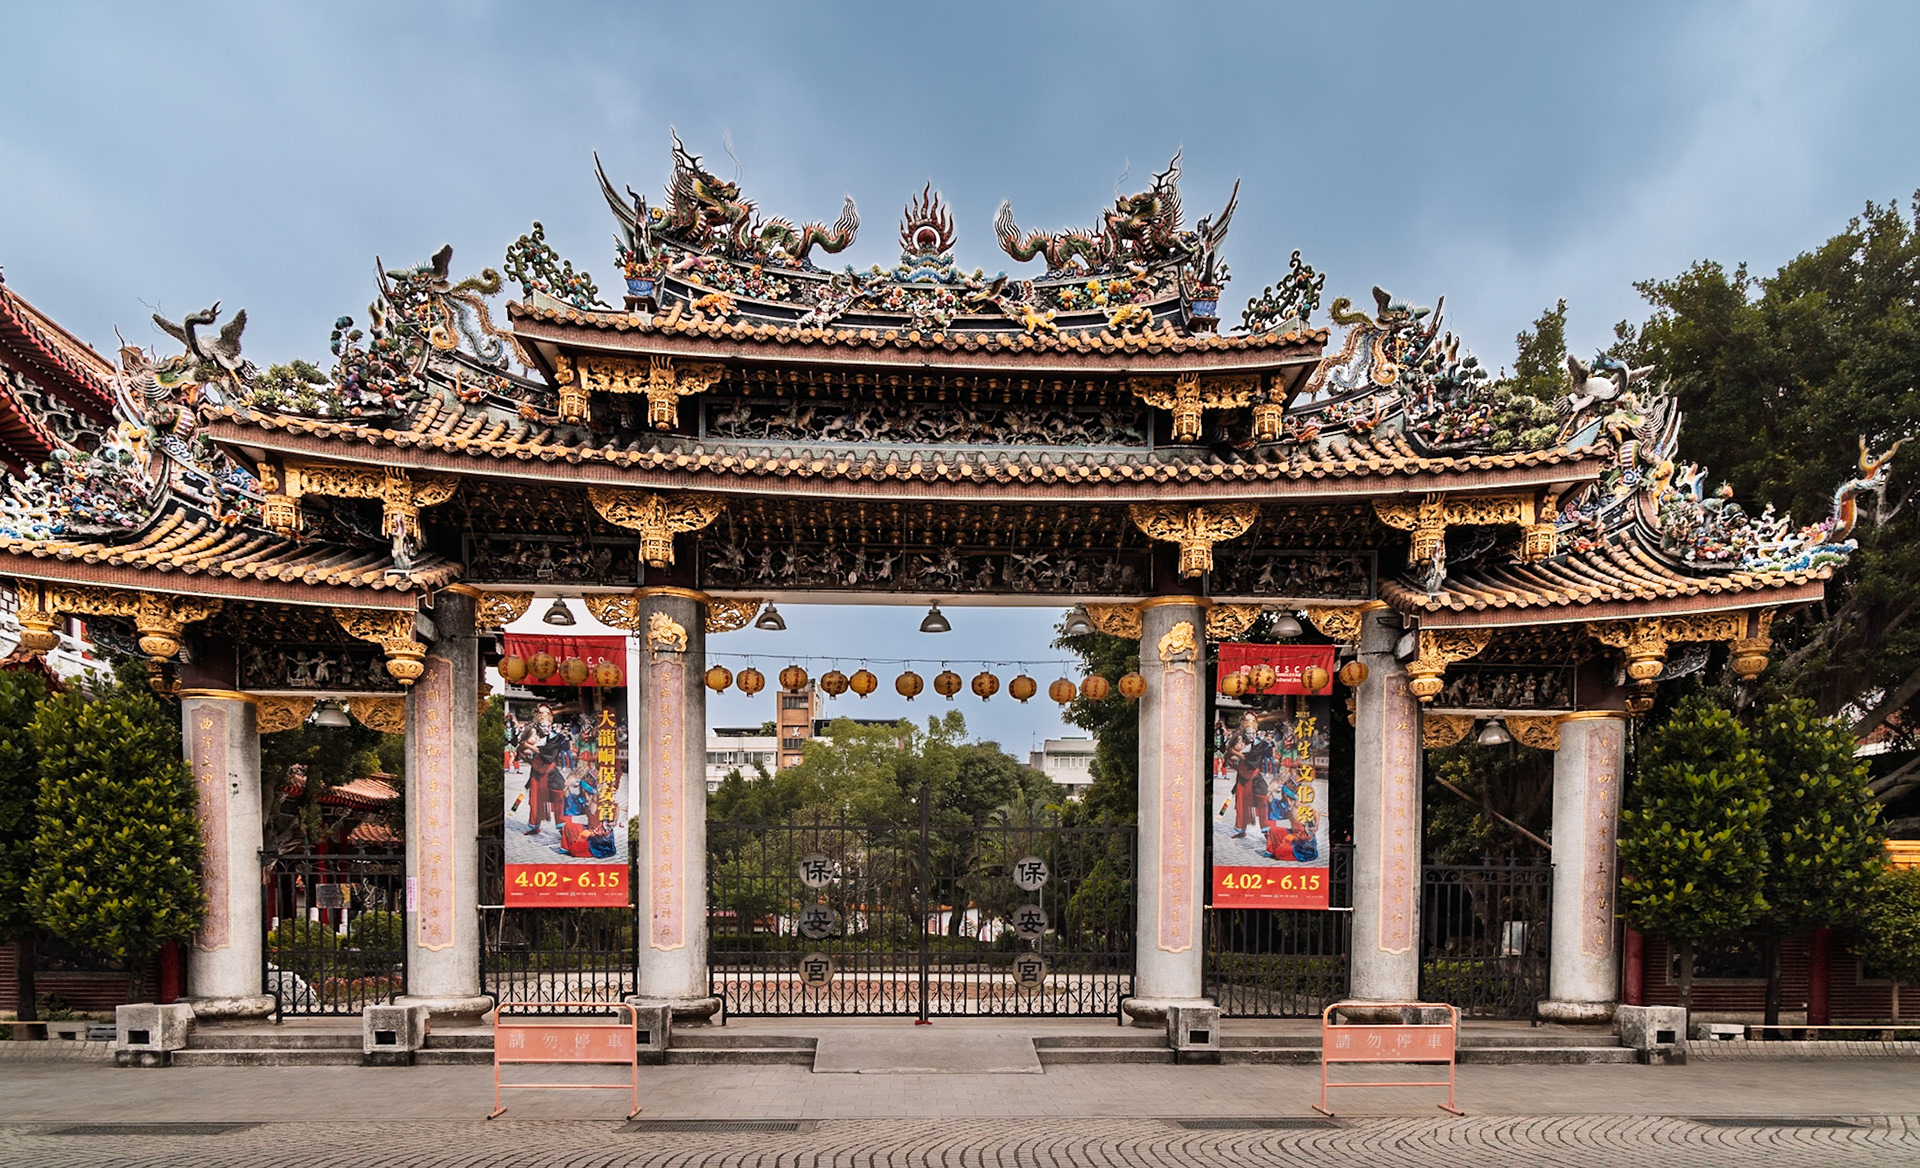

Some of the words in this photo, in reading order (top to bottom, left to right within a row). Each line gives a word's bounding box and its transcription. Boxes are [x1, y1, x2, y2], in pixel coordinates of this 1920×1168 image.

[597, 709, 616, 821] 大龍峒保安宮
[1294, 717, 1318, 823] 保生文化祭
[514, 871, 558, 887] 4.02
[577, 872, 620, 888] 6.15
[1221, 873, 1263, 889] 4.02
[1280, 874, 1321, 890] 6.15
[803, 860, 834, 983] 保安宮
[1016, 861, 1047, 983] 保安宮
[508, 1033, 623, 1049] 請勿停車
[1335, 1033, 1442, 1049] 請勿停車
